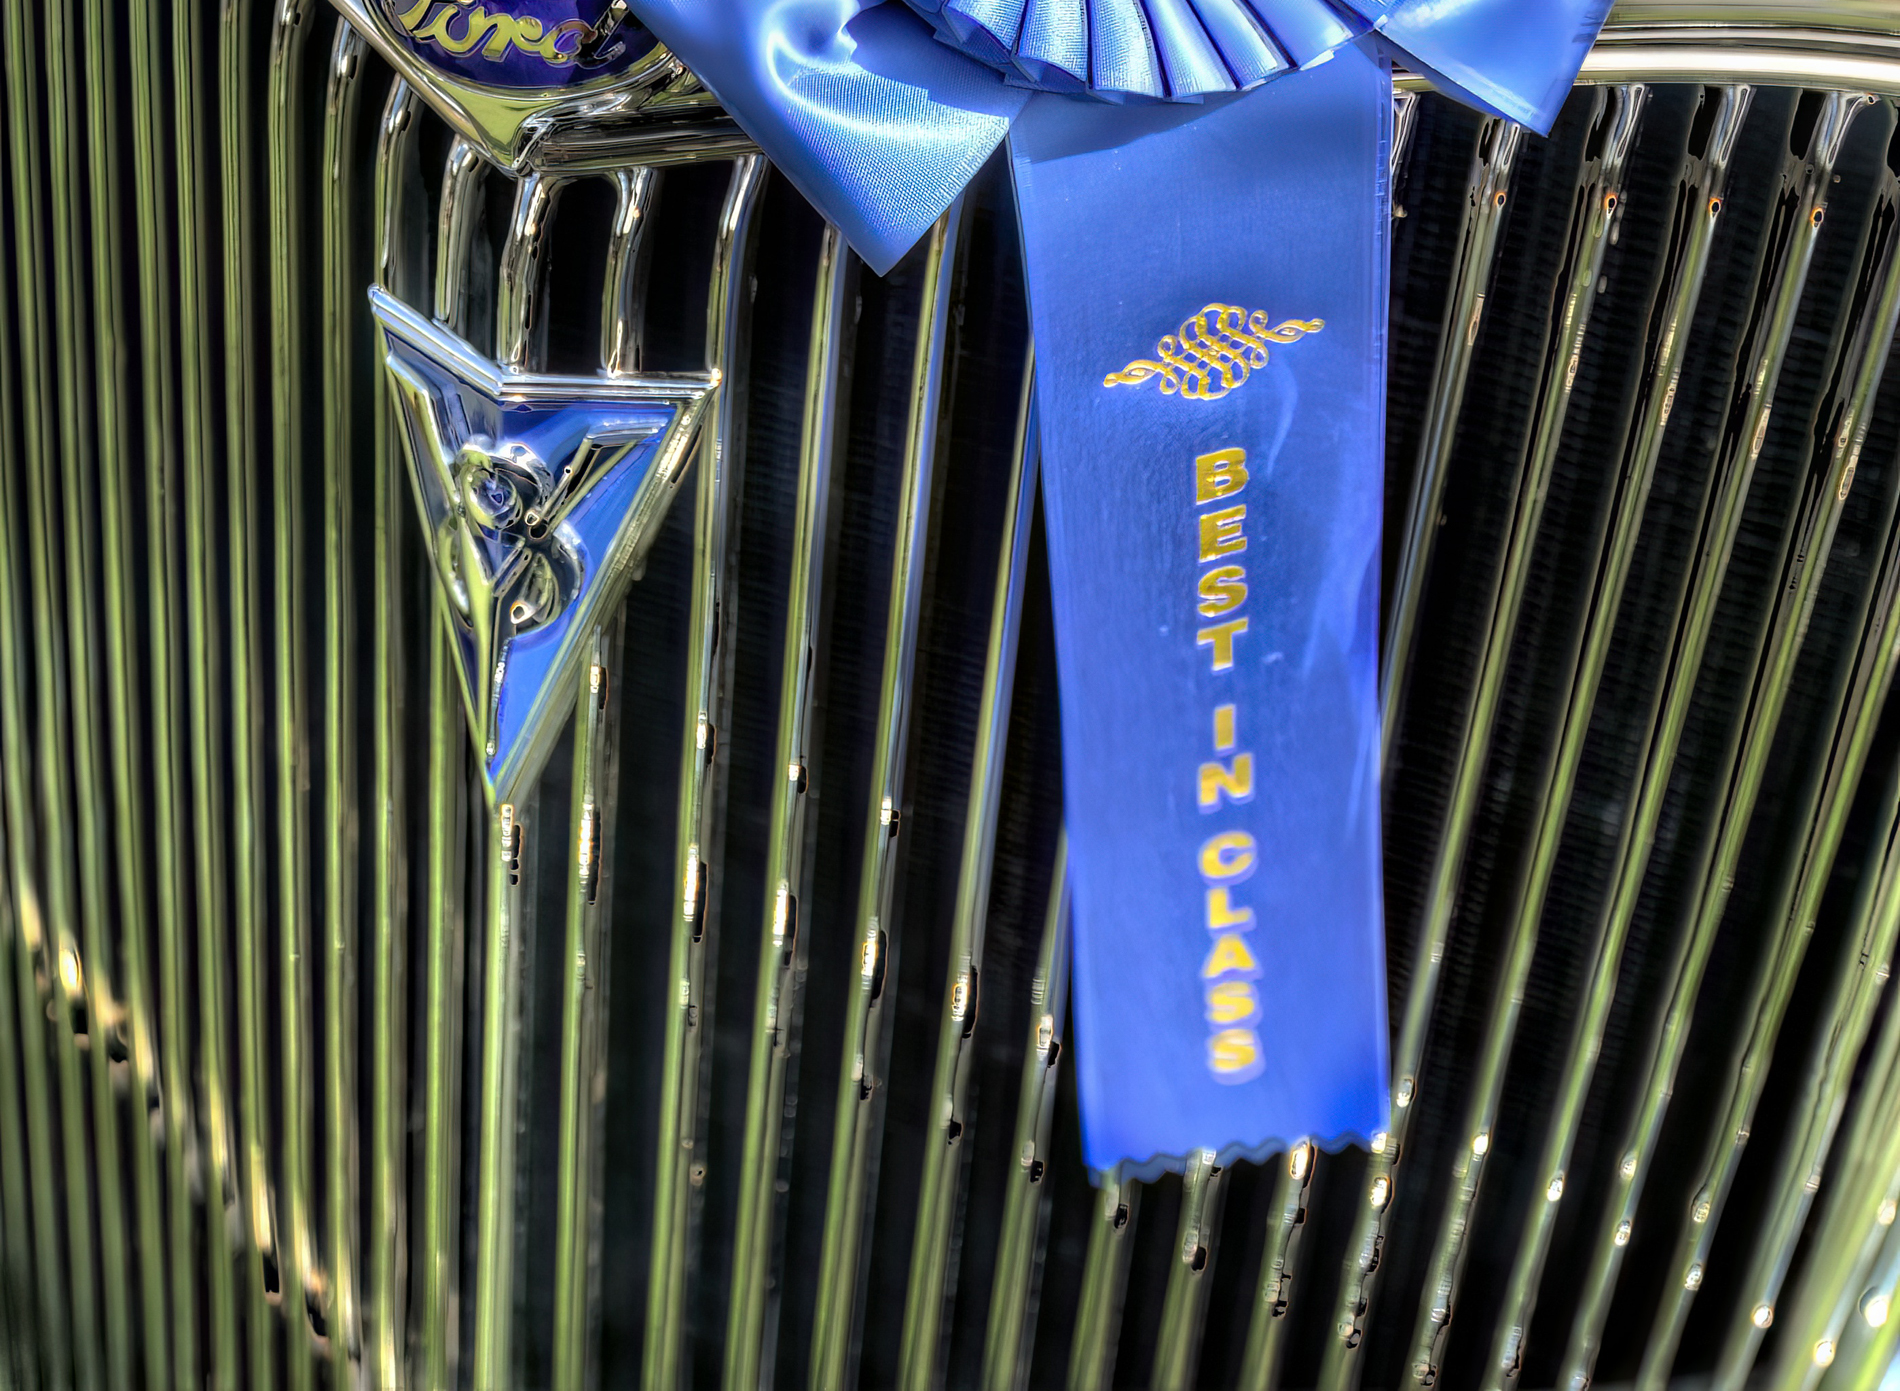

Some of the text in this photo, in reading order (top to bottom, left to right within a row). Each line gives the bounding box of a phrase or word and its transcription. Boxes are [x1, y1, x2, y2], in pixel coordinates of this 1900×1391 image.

[1195, 447, 1263, 1082] BEST IN CLASS
